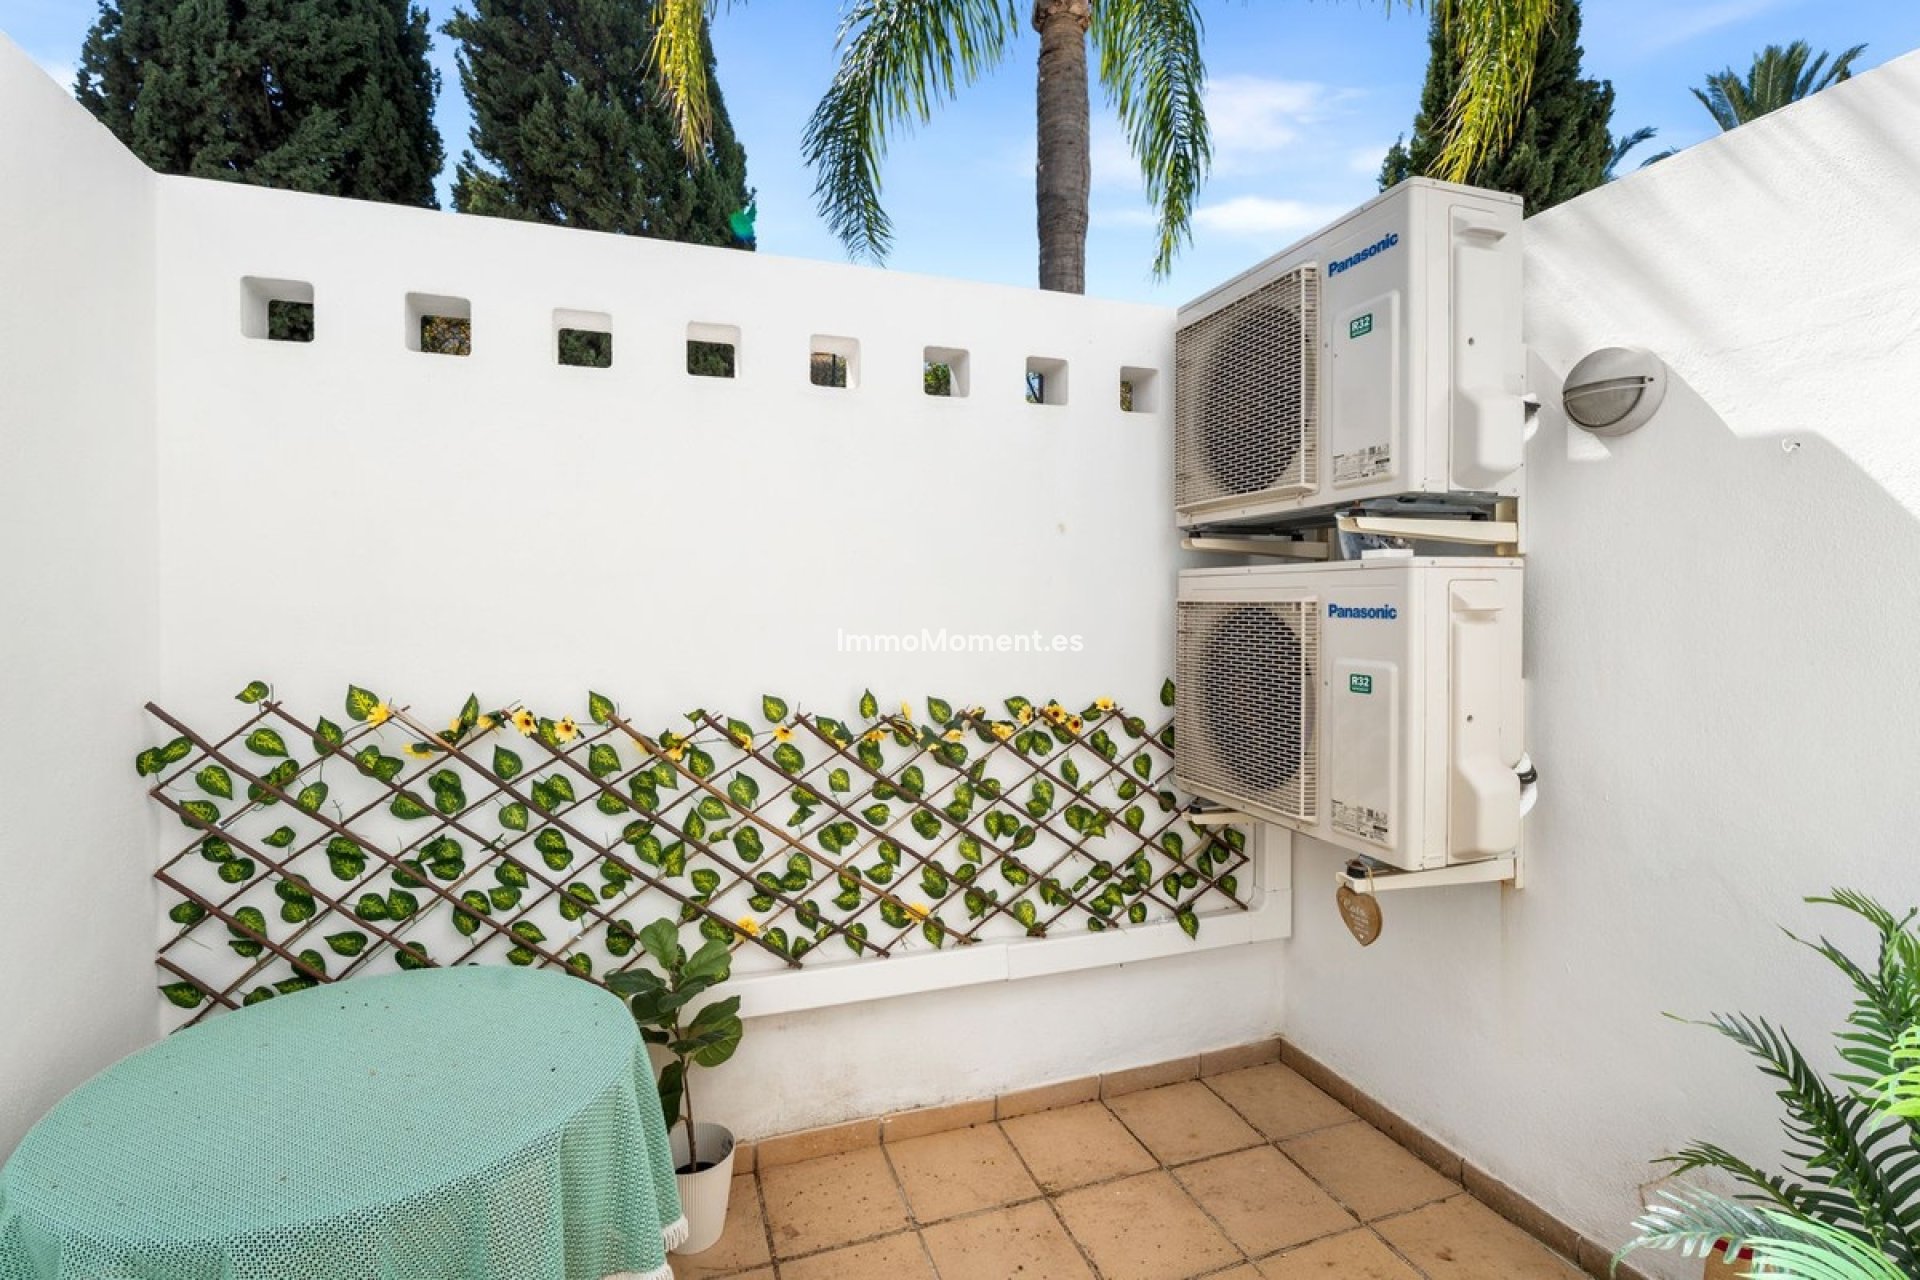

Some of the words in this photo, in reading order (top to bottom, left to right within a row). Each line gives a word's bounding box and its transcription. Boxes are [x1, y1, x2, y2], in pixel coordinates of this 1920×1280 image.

[1328, 233, 1399, 277] Panasonic
[1351, 316, 1370, 330] R32
[1327, 603, 1398, 620] Panasonic
[1351, 676, 1370, 687] R32
